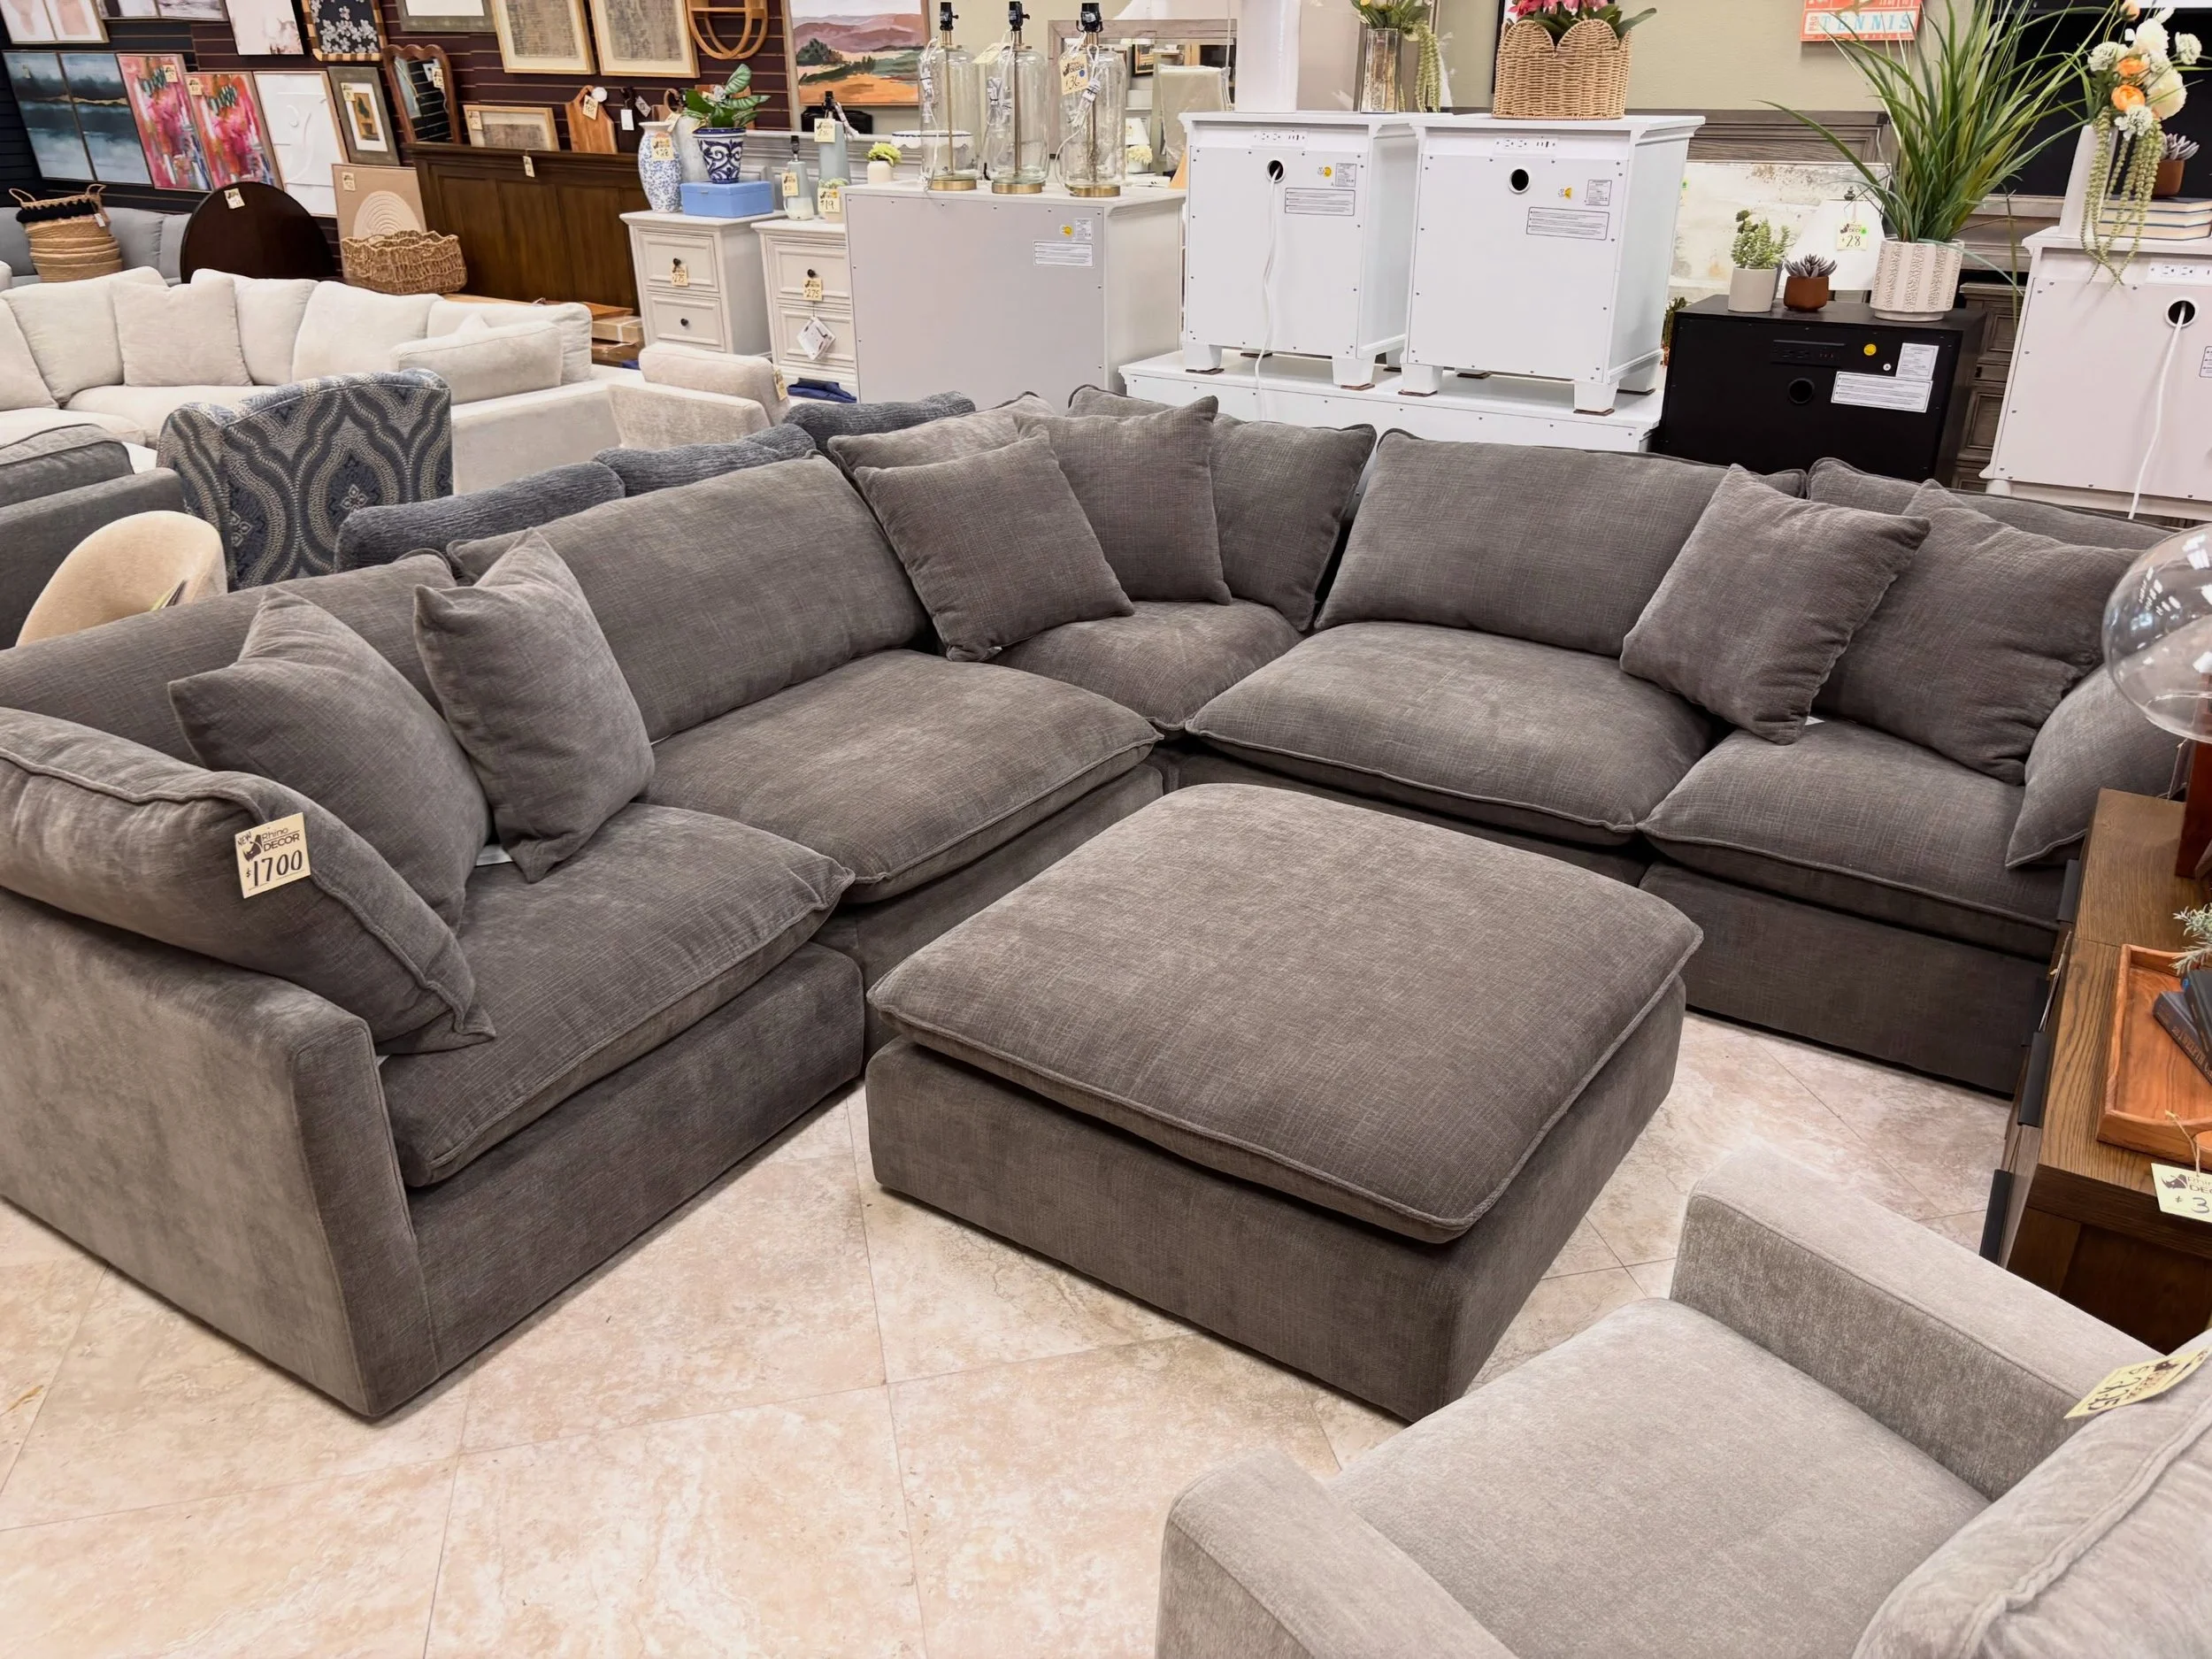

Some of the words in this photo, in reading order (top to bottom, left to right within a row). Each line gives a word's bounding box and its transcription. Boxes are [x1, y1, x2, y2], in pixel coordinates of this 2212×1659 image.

[1821, 12, 1913, 31] TENNIS
[261, 827, 288, 841] Rhino
[263, 833, 300, 852] DECOR
[246, 849, 303, 887] $1700
